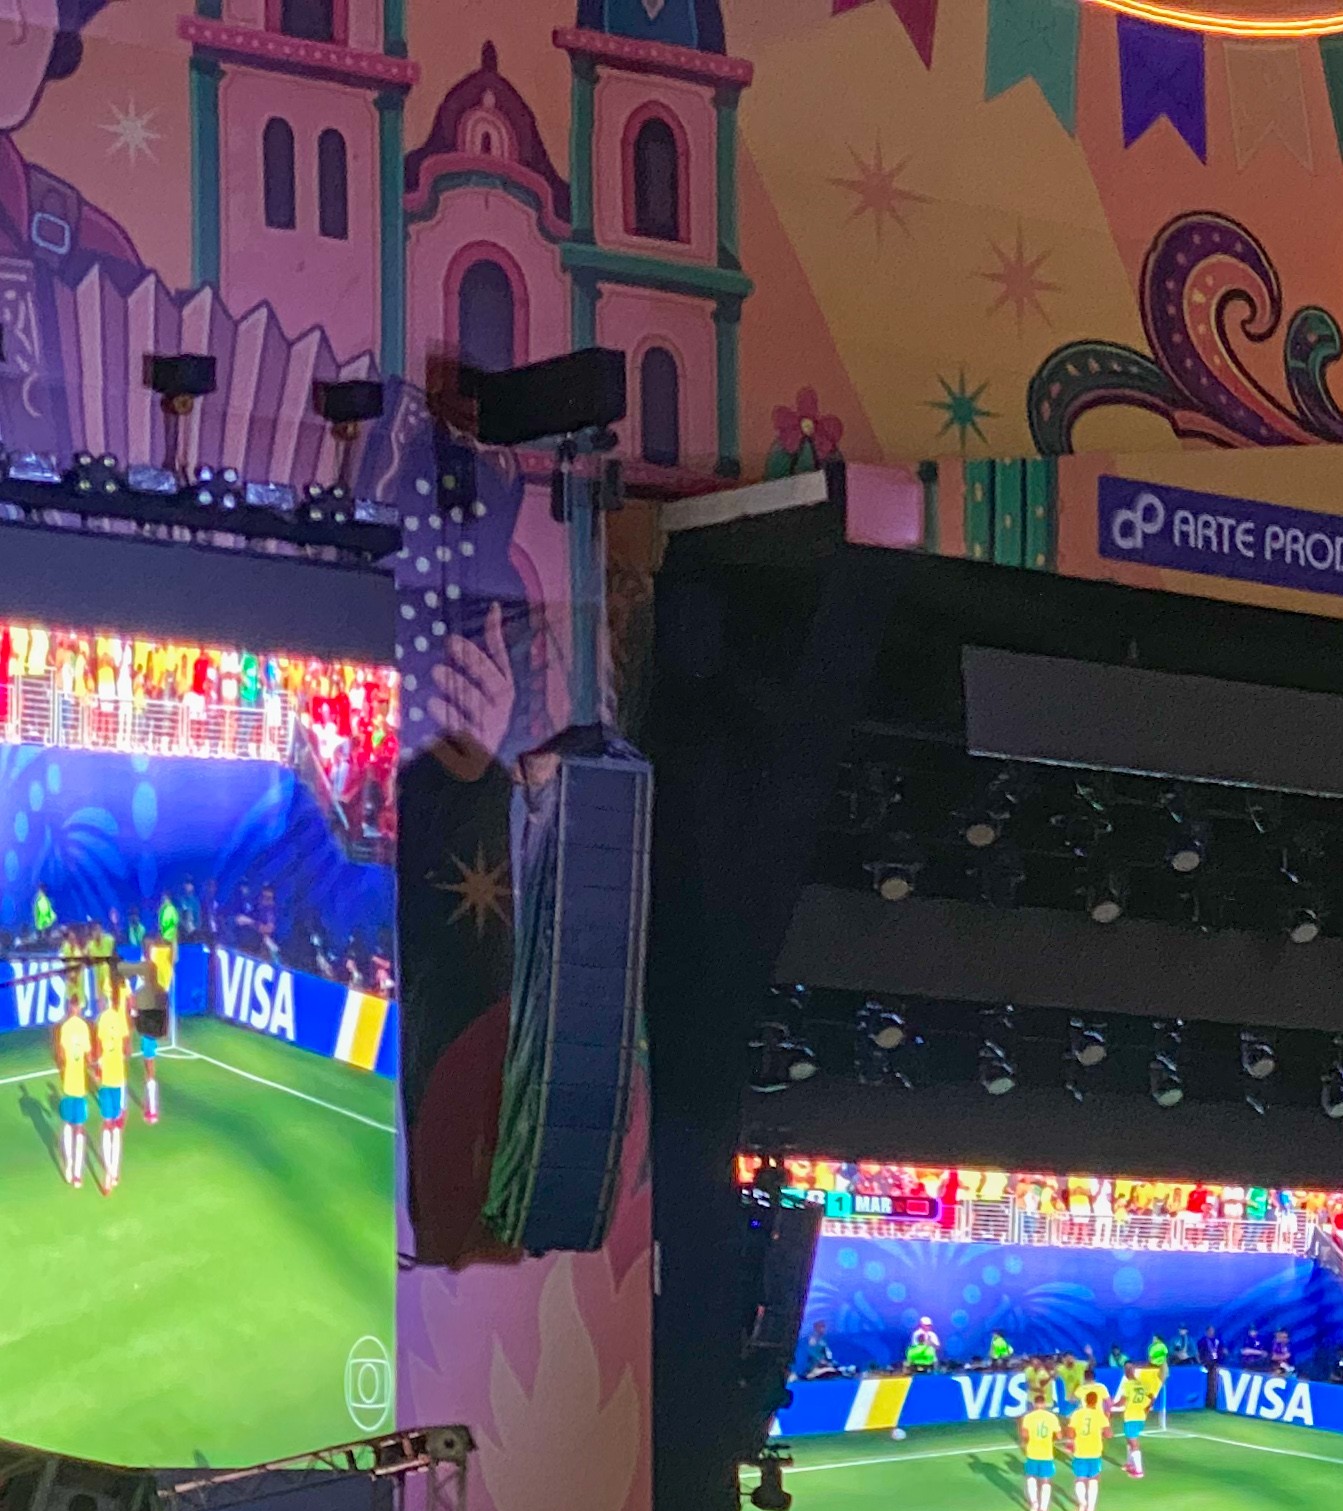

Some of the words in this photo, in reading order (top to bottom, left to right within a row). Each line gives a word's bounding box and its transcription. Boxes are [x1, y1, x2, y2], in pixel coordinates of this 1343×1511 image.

[1173, 509, 1255, 559] ARTE
[11, 957, 93, 1027] VIS
[215, 947, 297, 1042] VISA
[854, 1193, 893, 1214] MAR
[954, 1372, 1060, 1420] VIS
[1218, 1369, 1315, 1426] VISA
